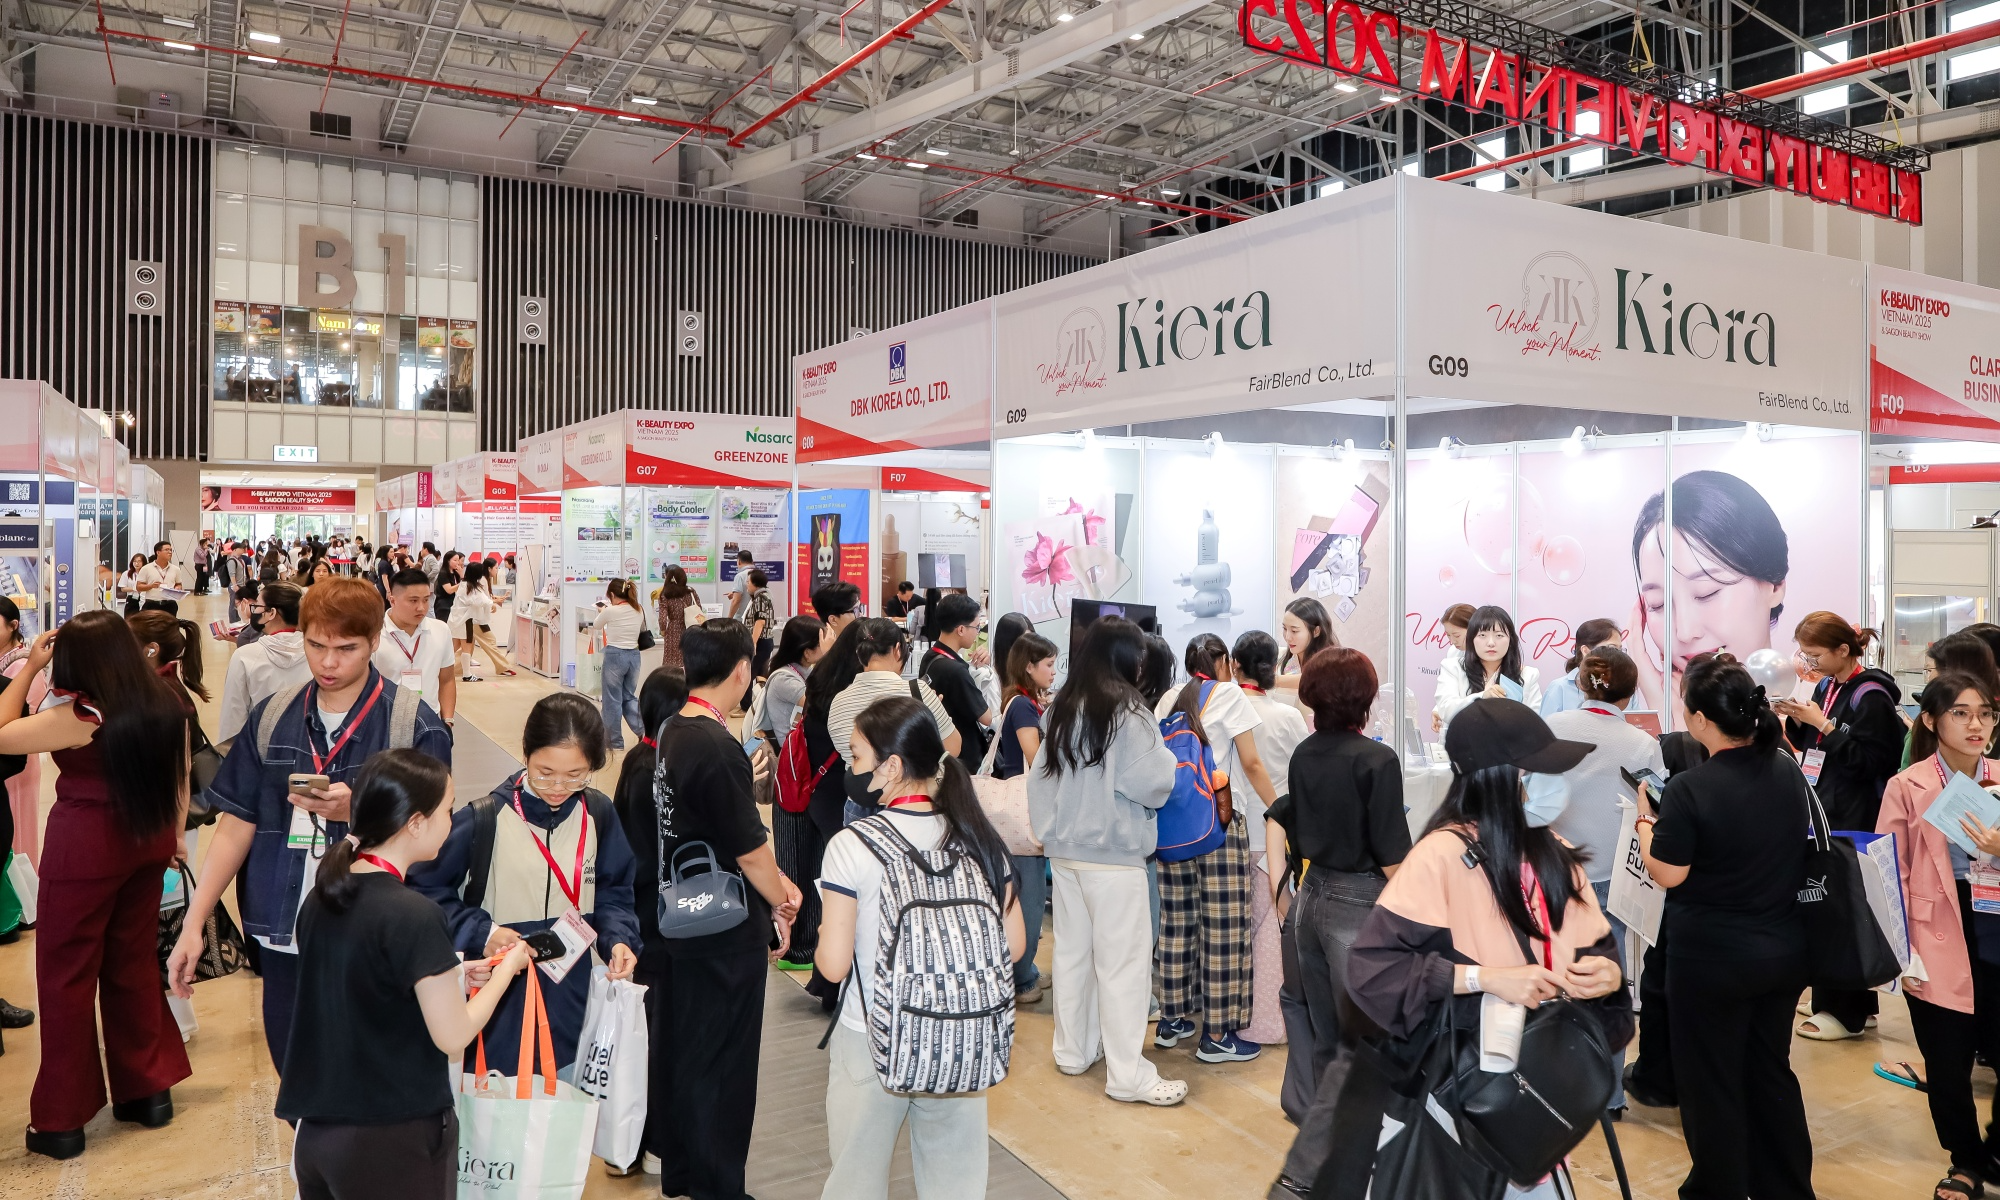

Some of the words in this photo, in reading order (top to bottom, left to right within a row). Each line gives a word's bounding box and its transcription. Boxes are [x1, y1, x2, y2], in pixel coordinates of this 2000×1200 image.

[299, 224, 406, 315] B1
[1881, 289, 1925, 312] K-BEAUTY
[1926, 299, 1950, 318] EXPO
[1487, 304, 1541, 334] Unlock
[1614, 268, 1777, 368] Kiera
[1882, 310, 1914, 325] VIETNAM
[1915, 315, 1932, 328] 2025
[1116, 290, 1273, 373] Kiera
[1522, 335, 1550, 355] your
[1548, 322, 1602, 362] Moment.
[1885, 328, 1902, 336] SAIGON
[1903, 330, 1917, 339] BEAUTY
[1918, 333, 1932, 341] SHOW
[802, 362, 823, 380] K-BEAUTY
[824, 360, 837, 375] EXPO
[890, 367, 905, 381] DBK
[1036, 362, 1068, 384] Unlock
[1248, 372, 1311, 393] FairBlend
[1318, 366, 1344, 384] Co.,
[1348, 359, 1376, 378] Ltd.
[1428, 355, 1469, 378] G09
[851, 397, 869, 417] DBK
[872, 390, 903, 413] KOREA
[906, 386, 925, 408] CO.,
[928, 381, 950, 403] LTD.
[1758, 392, 1808, 411] FairBlend
[1834, 398, 1852, 414] Ltd.
[1881, 394, 1904, 415] F09
[1006, 408, 1027, 425] G09
[278, 448, 314, 457] EXIT
[802, 436, 814, 449] G08
[714, 451, 788, 463] GREENZONE
[636, 466, 657, 475] G07
[890, 474, 906, 482] F07
[658, 505, 678, 514] Body
[458, 1146, 514, 1180] iera
